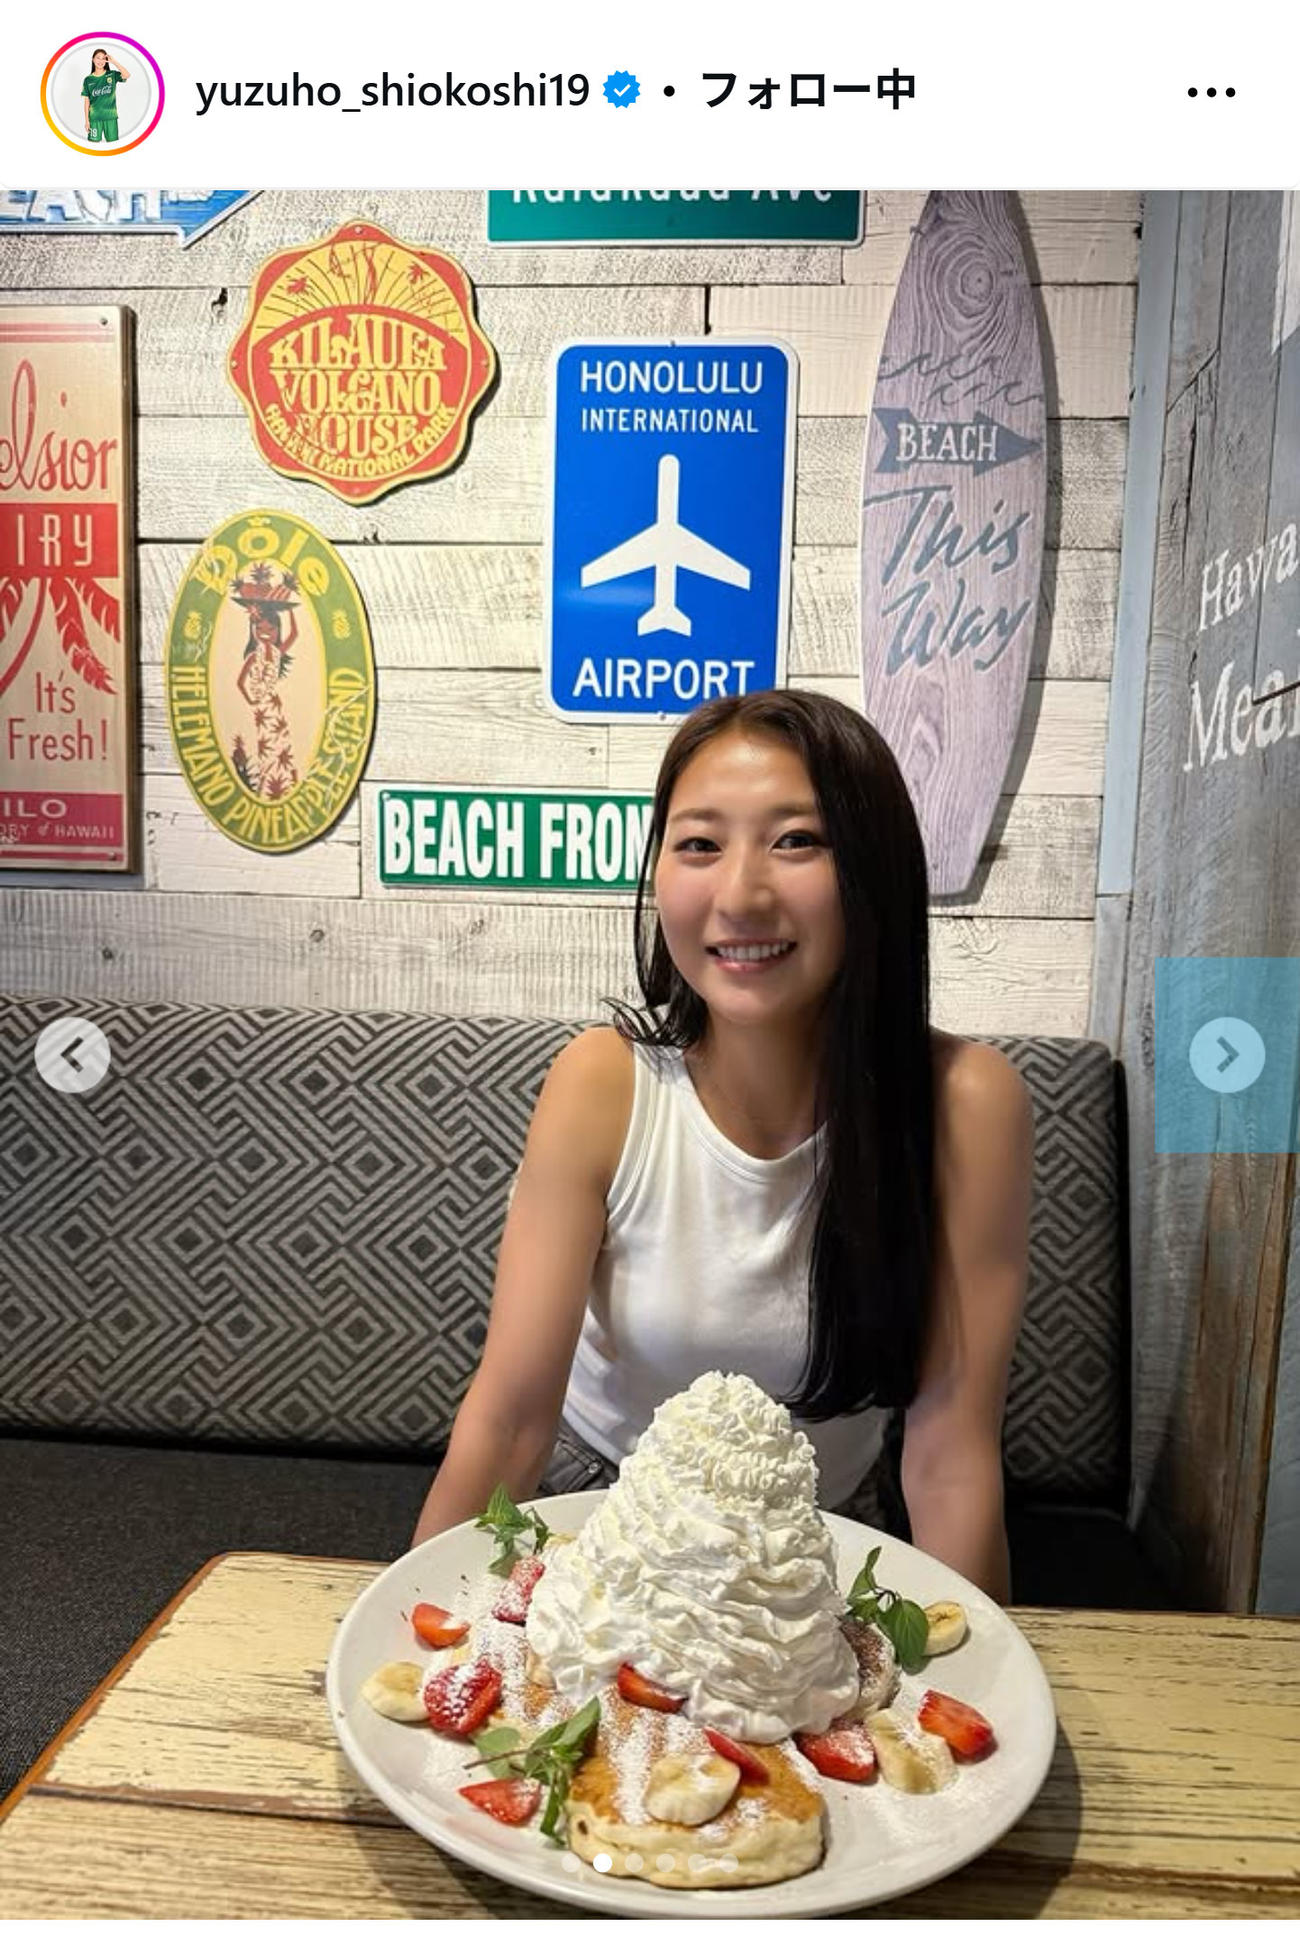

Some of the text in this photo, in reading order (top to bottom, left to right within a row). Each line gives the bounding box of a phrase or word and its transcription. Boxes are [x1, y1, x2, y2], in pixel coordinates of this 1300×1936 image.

[268, 313, 447, 371] KILAUEA
[270, 369, 442, 417] VOLCANO
[580, 360, 764, 394] HONOLULU
[294, 413, 419, 458] HOUSE
[318, 446, 415, 478] NATIONAL
[411, 402, 457, 456] PARK
[581, 408, 760, 433] INTERNATIONAL
[896, 422, 999, 462] BEACH
[17, 513, 93, 567] IRY
[863, 485, 1031, 587] This
[1199, 523, 1300, 632] Hawa
[881, 577, 1032, 676] Way
[36, 670, 76, 714] It's
[572, 657, 755, 700] AIRPORT
[8, 718, 107, 760] Fresh!
[171, 664, 236, 807] HELEMANO
[322, 667, 367, 764] STAND
[3, 798, 67, 819] ILO
[54, 824, 115, 839] HAWAII
[384, 798, 525, 879] BEACH
